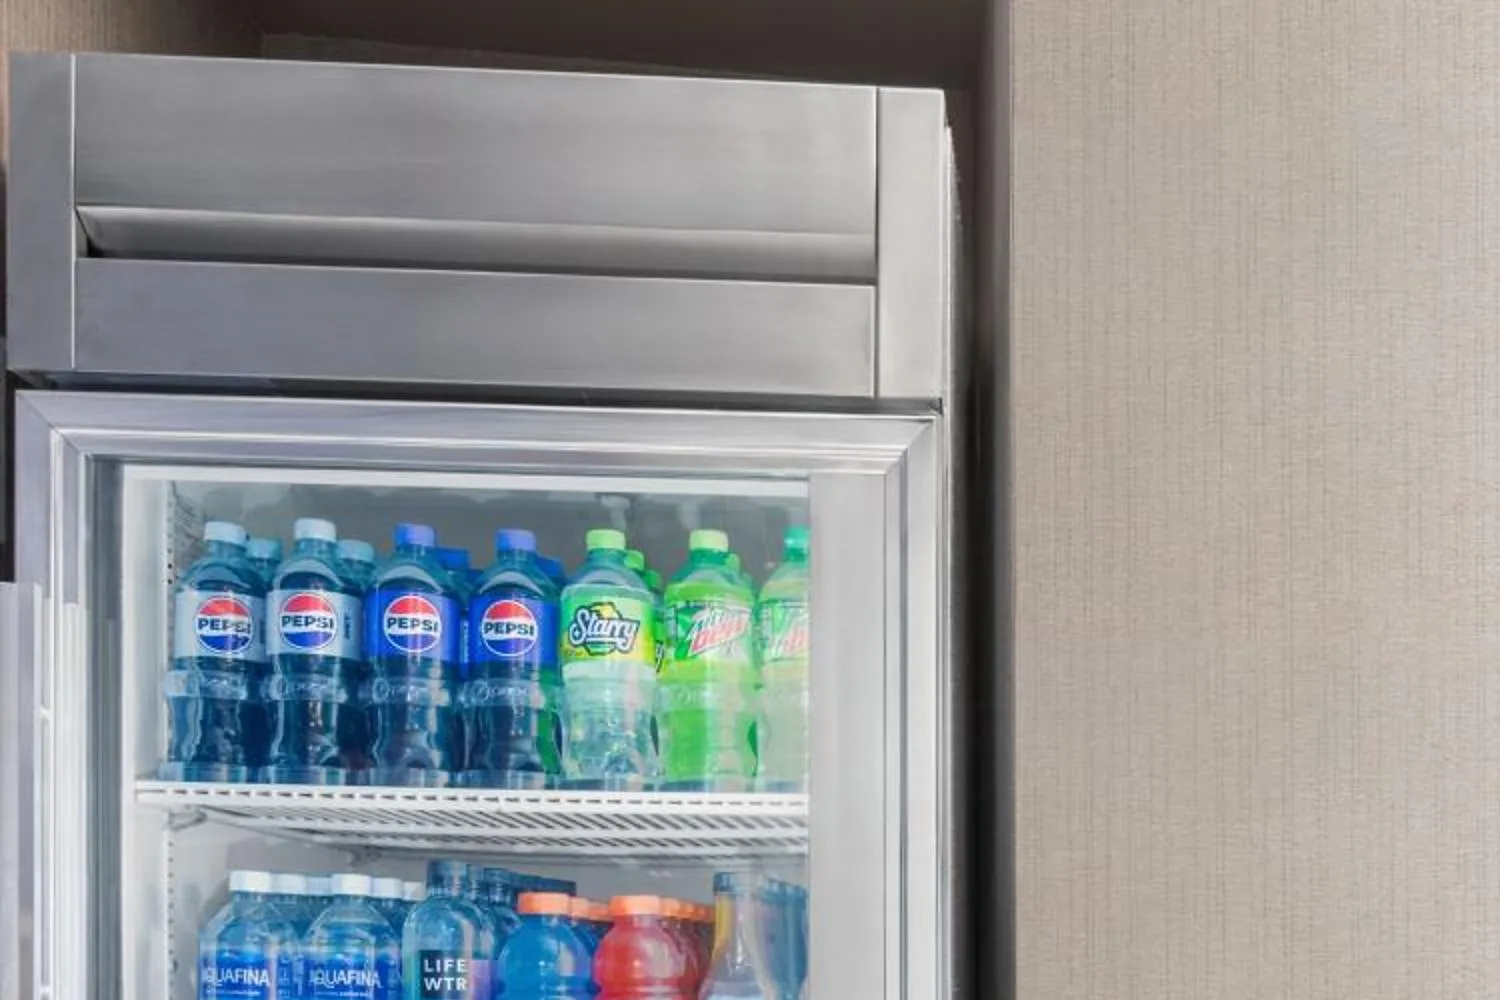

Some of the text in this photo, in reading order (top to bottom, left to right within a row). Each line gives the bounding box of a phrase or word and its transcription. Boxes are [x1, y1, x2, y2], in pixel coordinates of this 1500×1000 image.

[197, 617, 251, 633] PEPSI
[281, 615, 335, 630] PEPSI
[386, 617, 440, 633] PEPSI
[483, 621, 536, 636] PEPSI
[569, 608, 640, 653] Starry
[423, 958, 468, 974] LIFE
[423, 976, 469, 991] WTR
